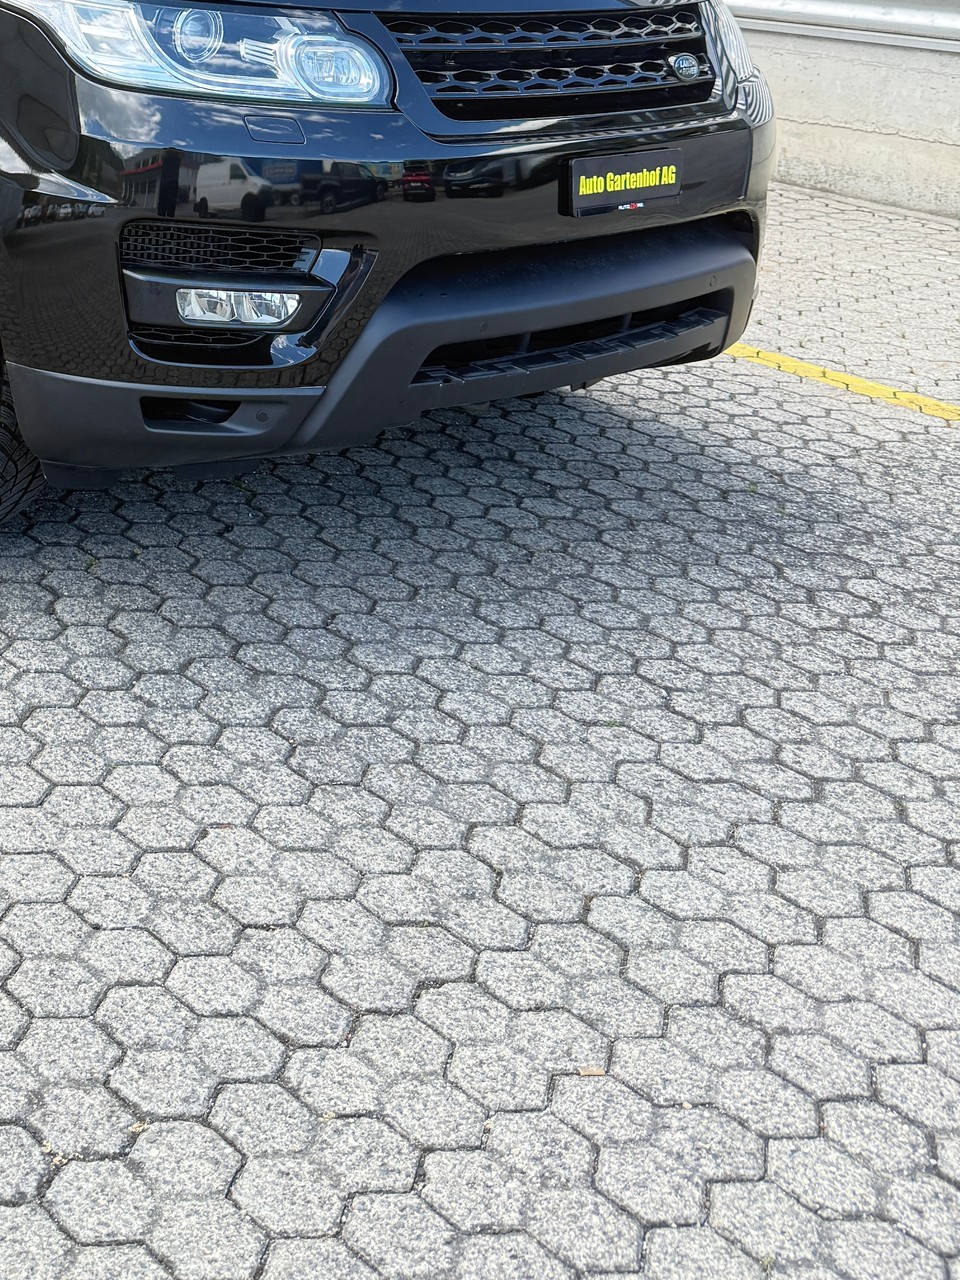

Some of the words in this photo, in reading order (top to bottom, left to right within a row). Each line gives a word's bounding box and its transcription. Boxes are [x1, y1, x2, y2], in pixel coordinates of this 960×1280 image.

[578, 175, 605, 195] Auto
[606, 166, 661, 192] Gartenhof
[661, 165, 676, 185] AG
